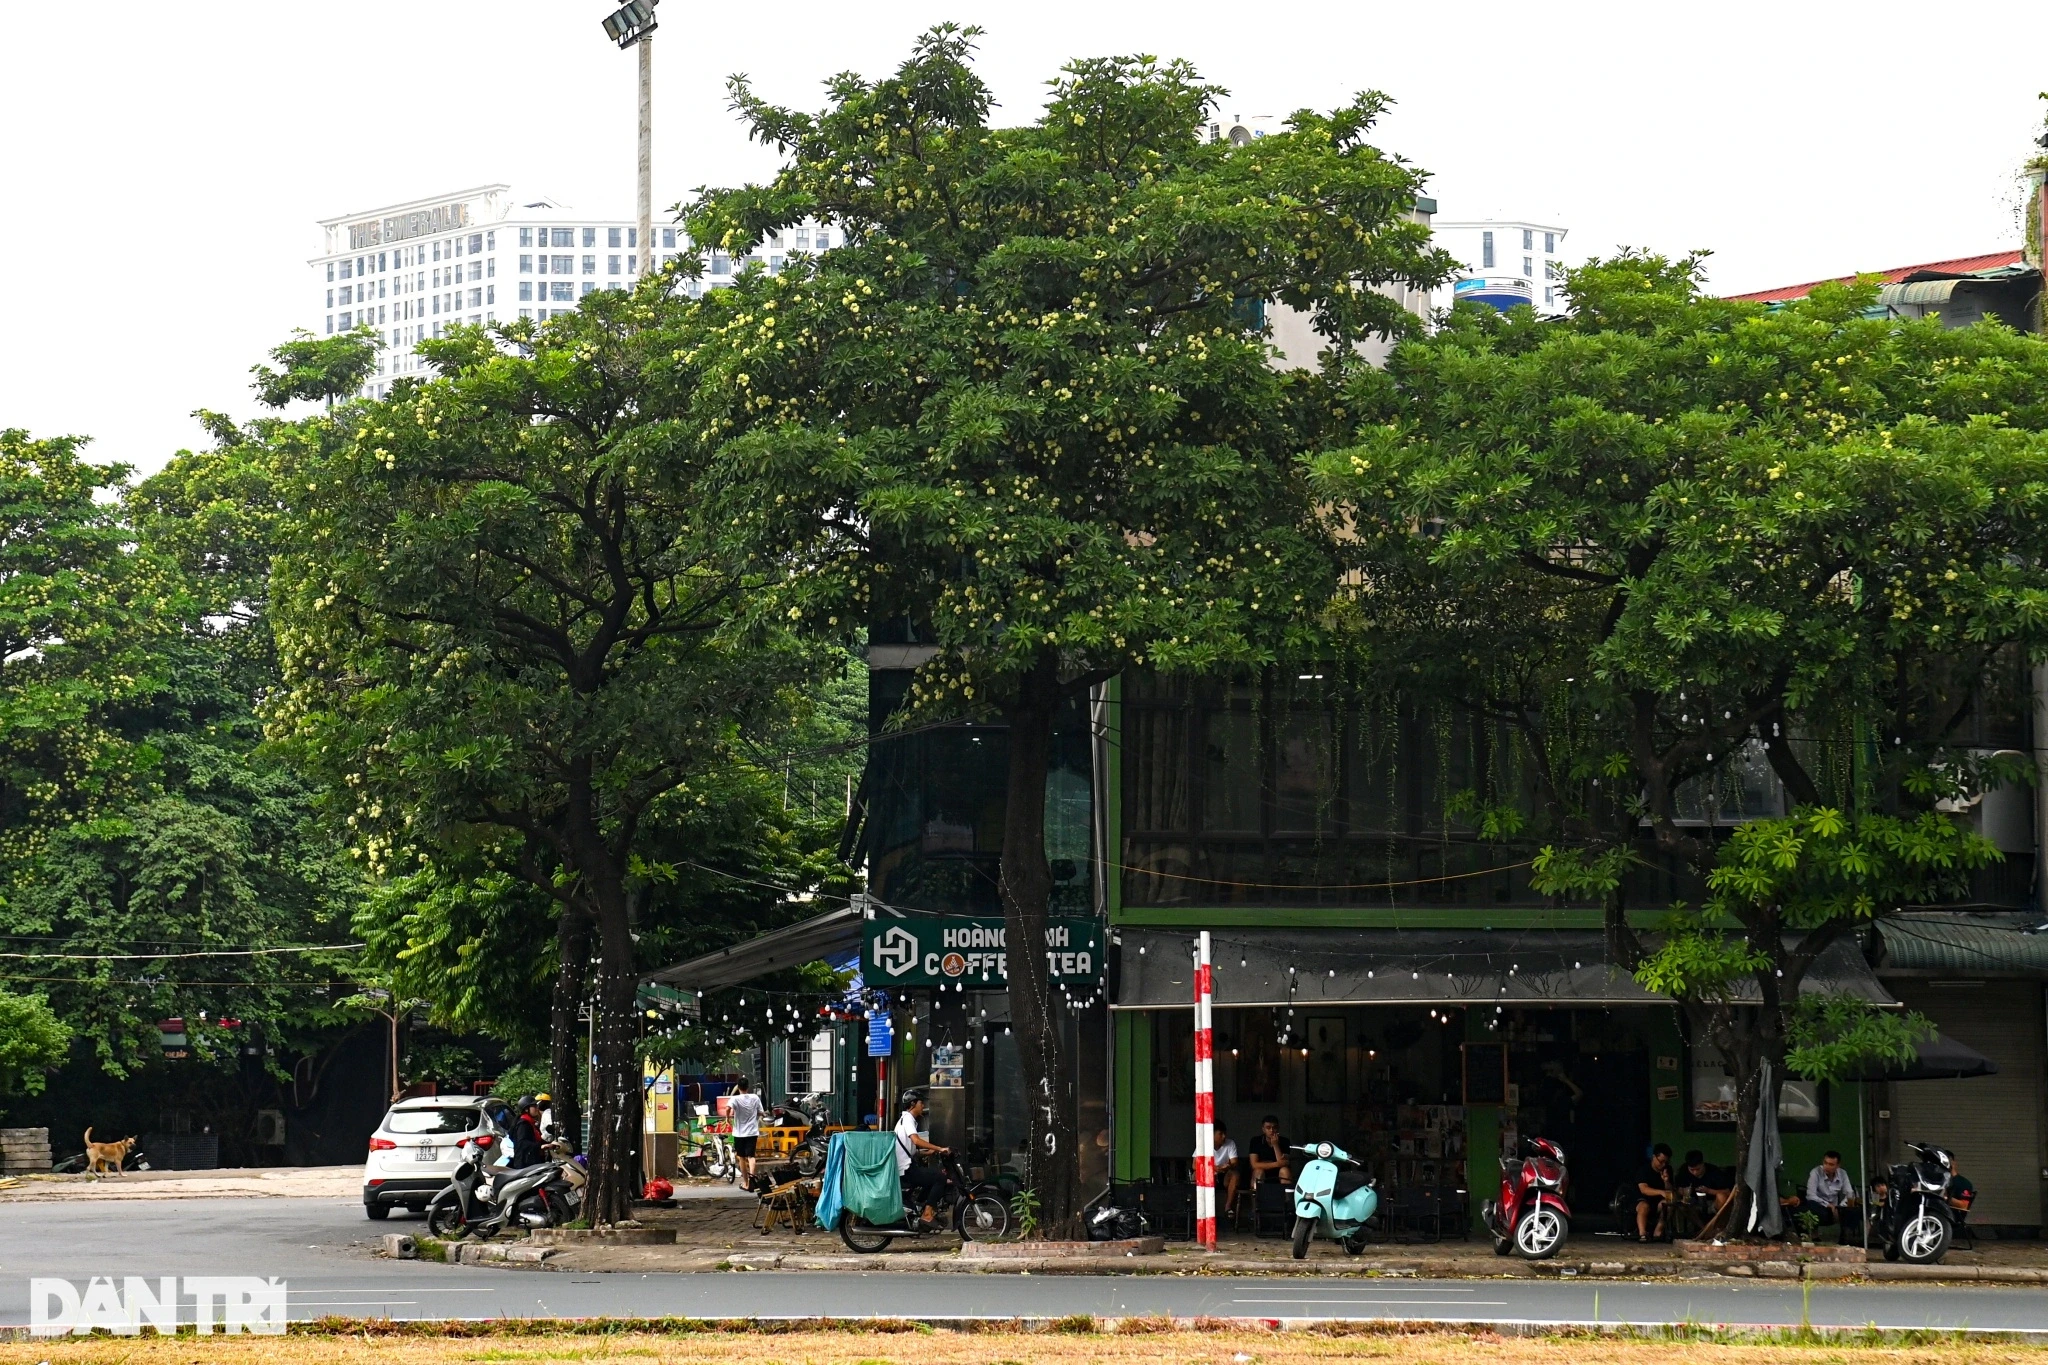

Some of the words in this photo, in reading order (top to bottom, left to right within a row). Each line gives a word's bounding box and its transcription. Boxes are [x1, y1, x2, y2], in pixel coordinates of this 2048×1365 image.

[348, 219, 379, 249] THE
[383, 204, 463, 243] EMERALD
[1046, 952, 1091, 974] TEA
